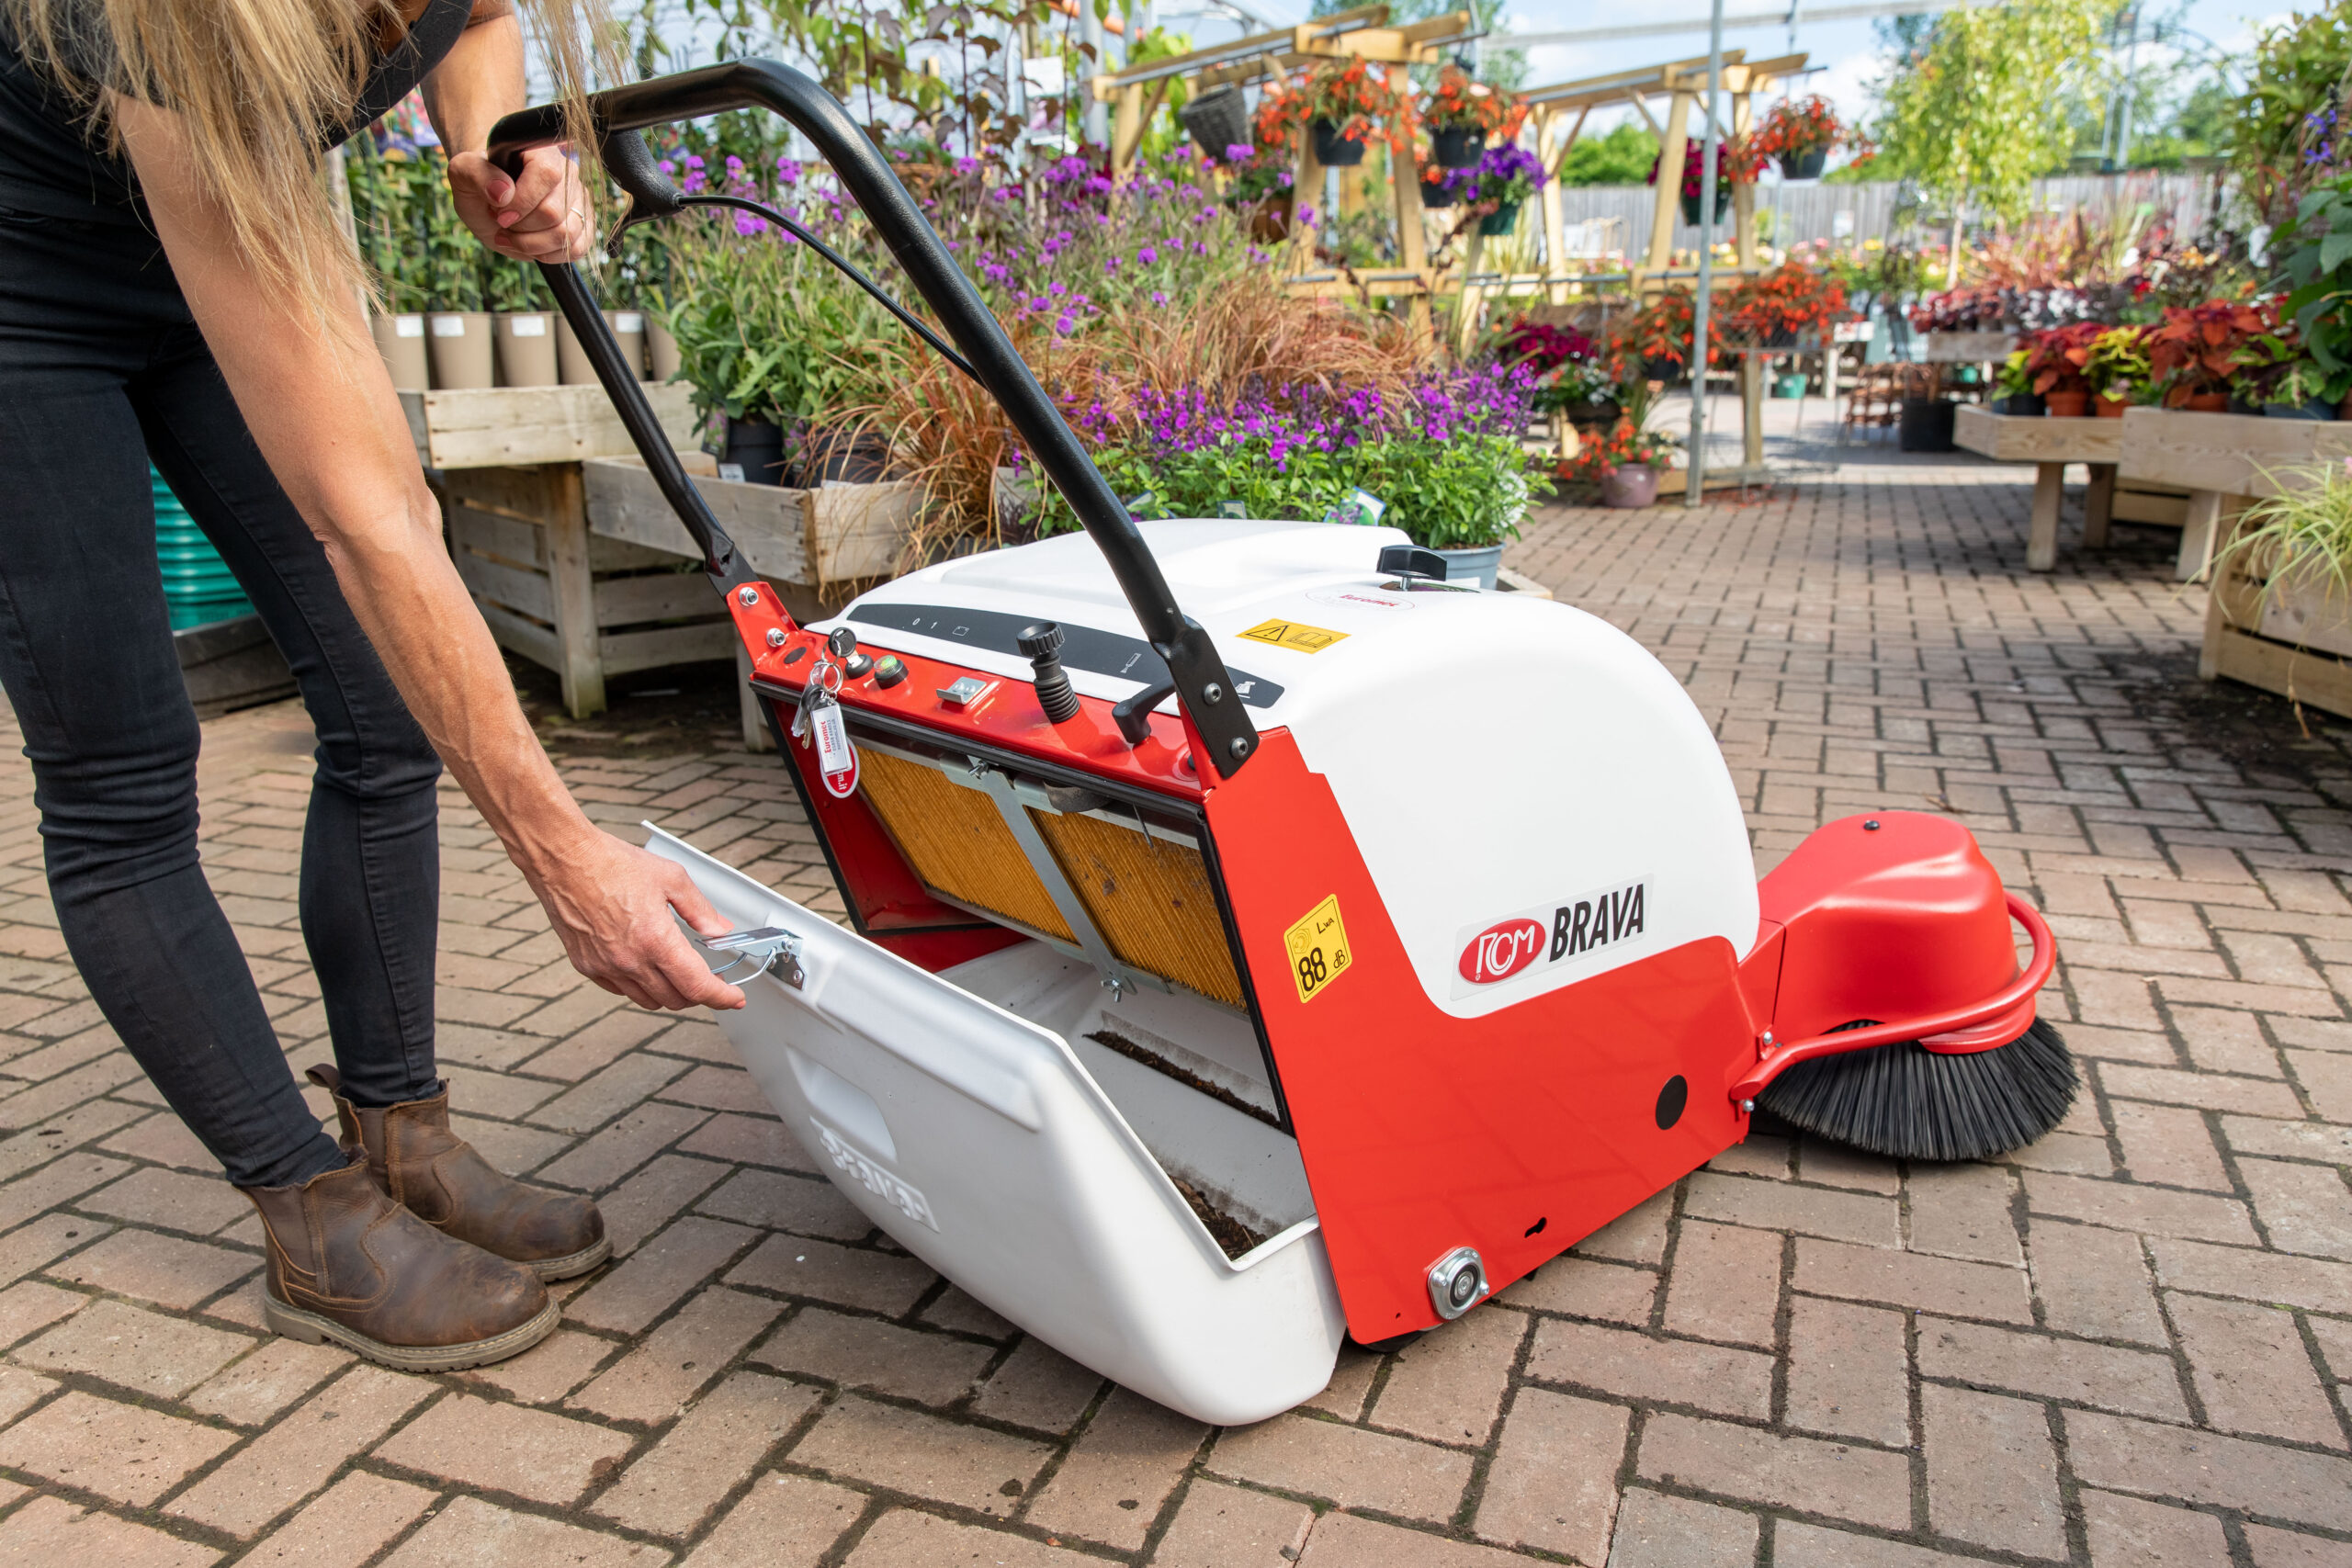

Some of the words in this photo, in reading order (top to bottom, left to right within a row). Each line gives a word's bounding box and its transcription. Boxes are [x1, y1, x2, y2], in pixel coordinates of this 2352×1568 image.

[820, 721, 831, 753] Euromec
[1549, 884, 1645, 963] BRAVA
[1298, 947, 1327, 992] 88
[1333, 949, 1346, 969] dB
